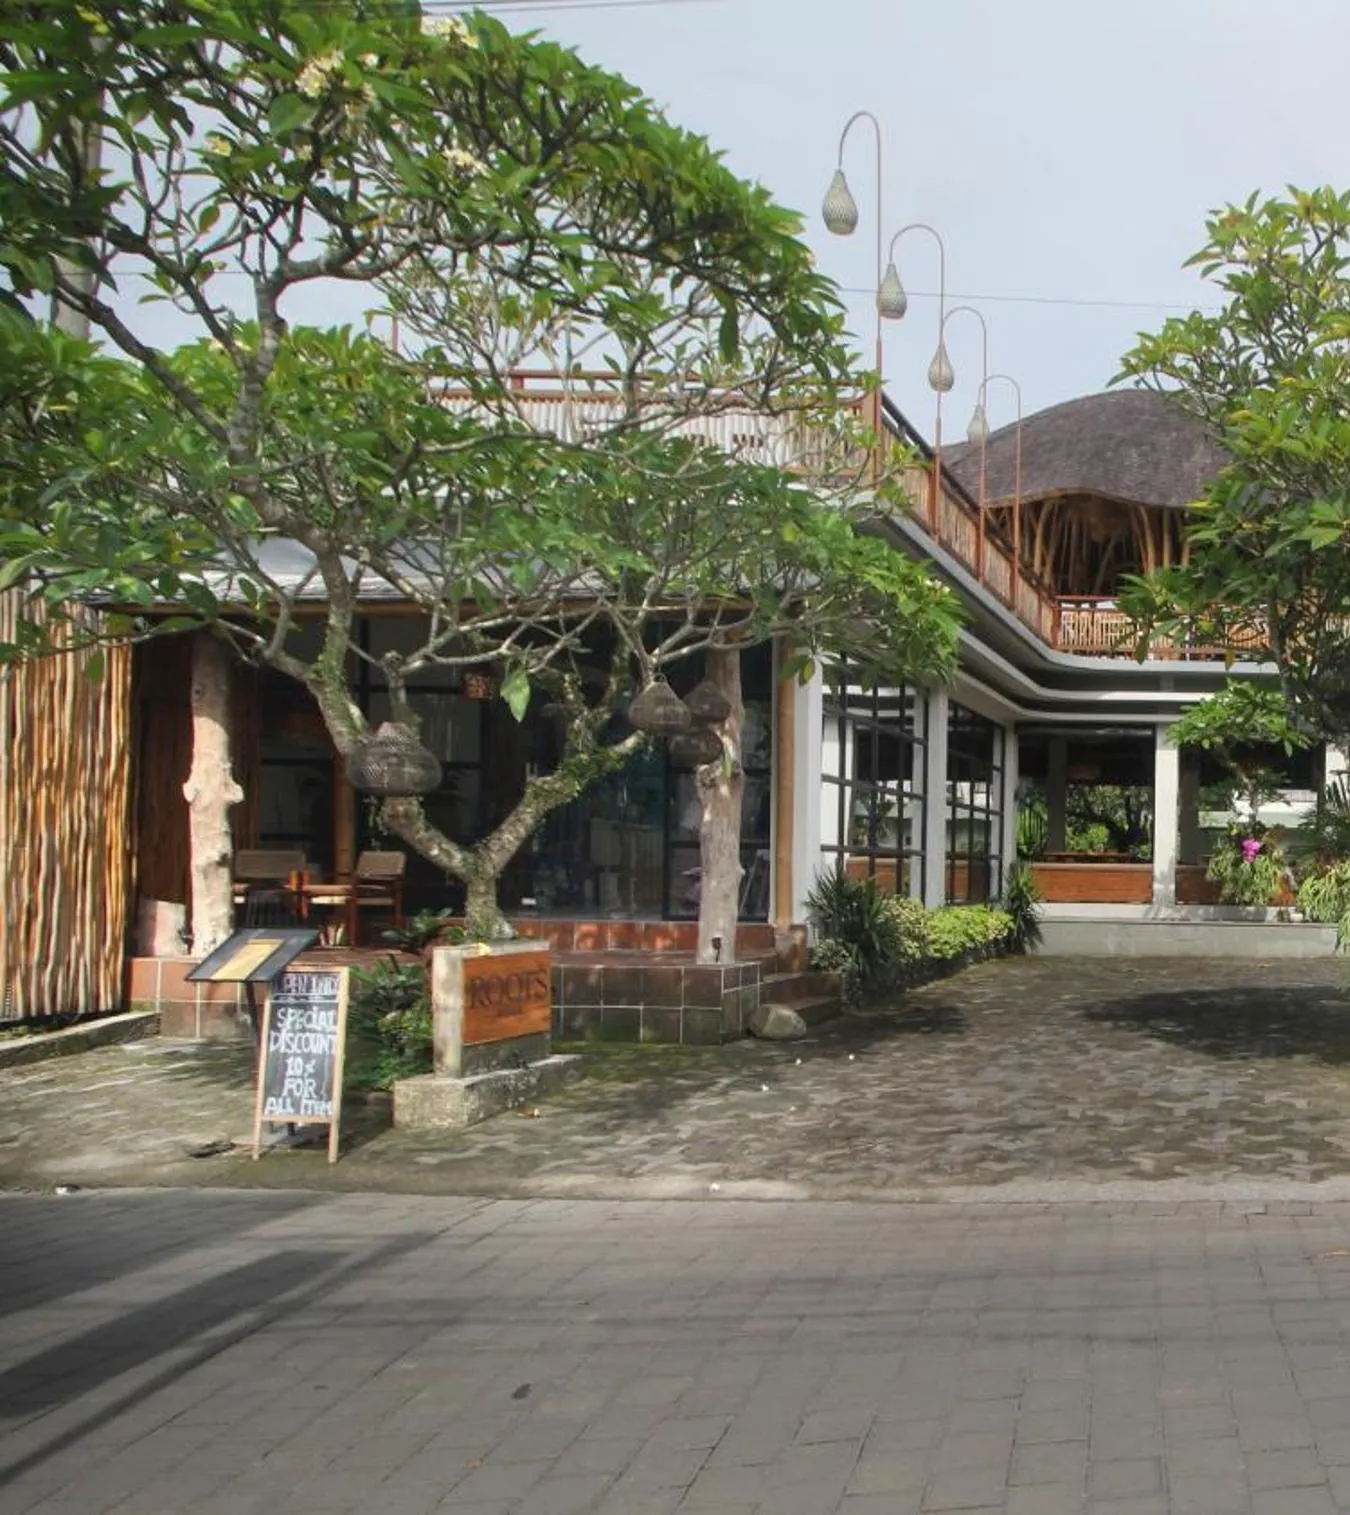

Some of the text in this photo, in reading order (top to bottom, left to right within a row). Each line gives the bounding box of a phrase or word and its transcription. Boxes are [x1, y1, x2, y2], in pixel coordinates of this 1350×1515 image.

[466, 968, 548, 1009] ROOTS
[269, 1031, 339, 1054] DISCOUNT
[281, 1077, 317, 1098] FOR
[264, 1097, 295, 1115] ALL
